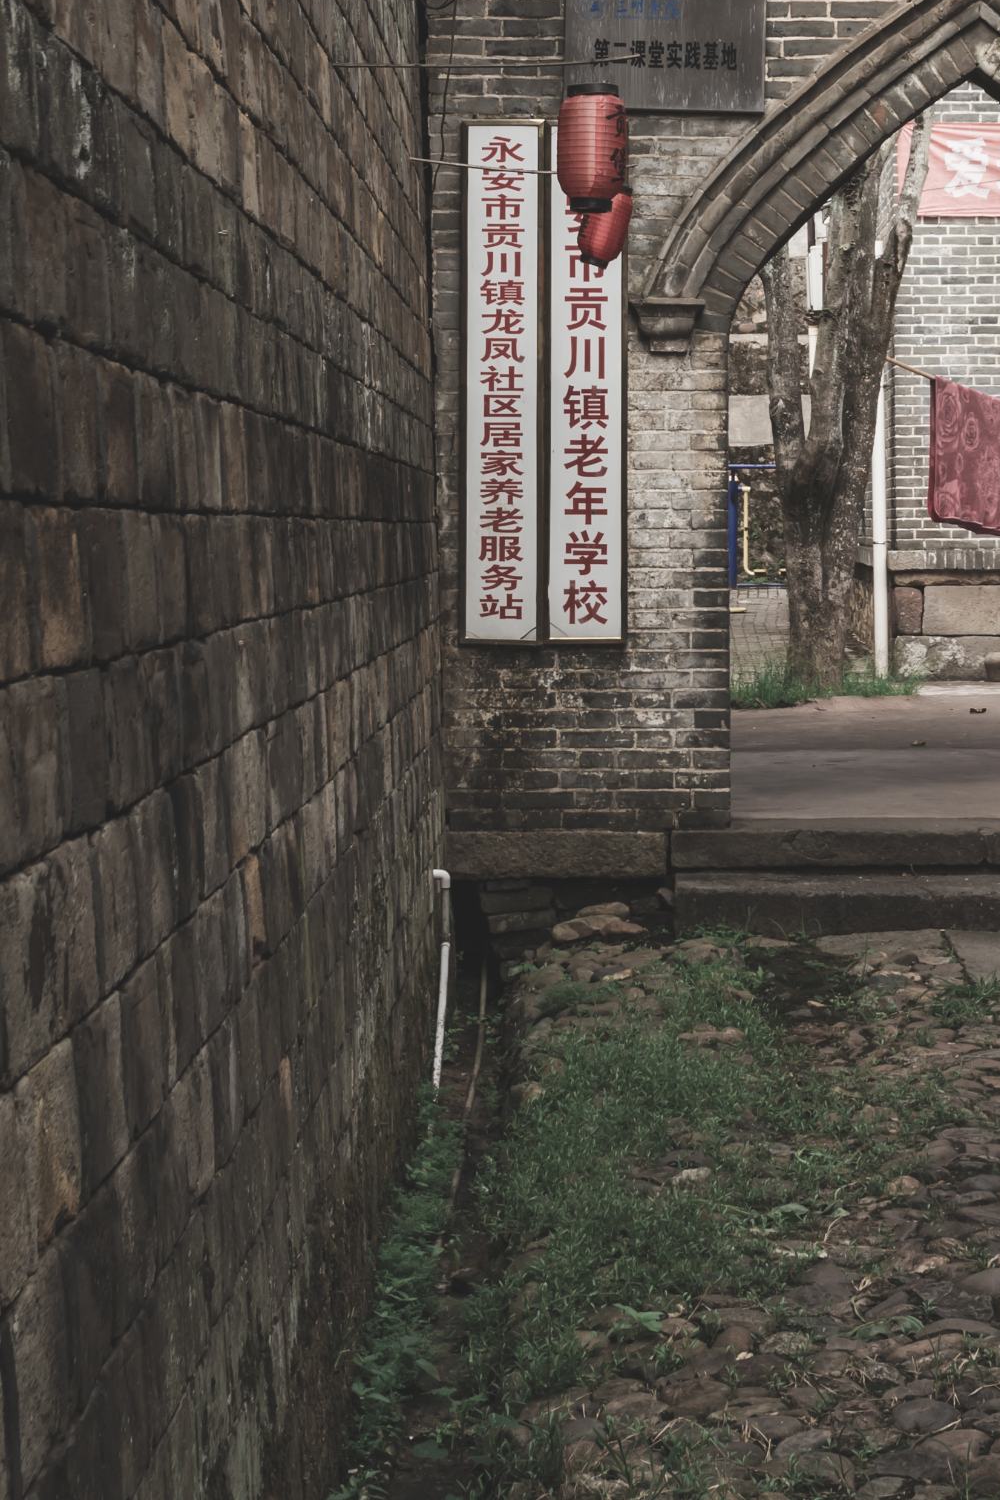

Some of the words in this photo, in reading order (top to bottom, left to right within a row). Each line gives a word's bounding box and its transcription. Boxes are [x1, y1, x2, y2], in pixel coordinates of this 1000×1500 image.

[593, 38, 738, 71] 第二课堂实践基地
[478, 135, 526, 621] 永安市贡川镇龙凤社区居家养老服务站
